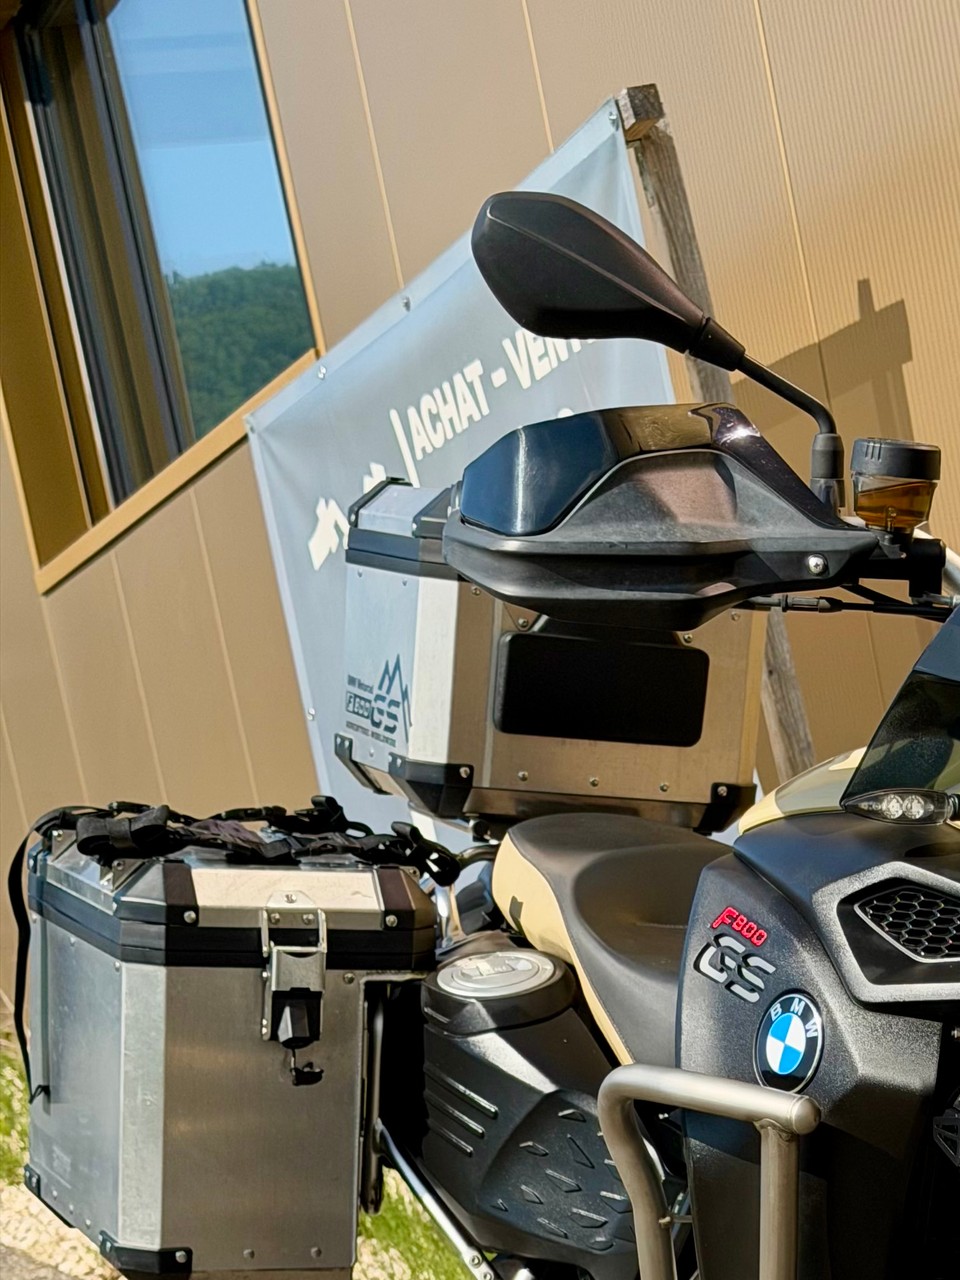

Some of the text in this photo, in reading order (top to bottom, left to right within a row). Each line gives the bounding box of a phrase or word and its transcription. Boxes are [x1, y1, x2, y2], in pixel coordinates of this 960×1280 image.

[407, 358, 490, 460] ACHAT
[502, 329, 592, 390] VEN
[712, 906, 768, 946] F800
[693, 933, 776, 1003] GS
[770, 997, 818, 1038] BMW
